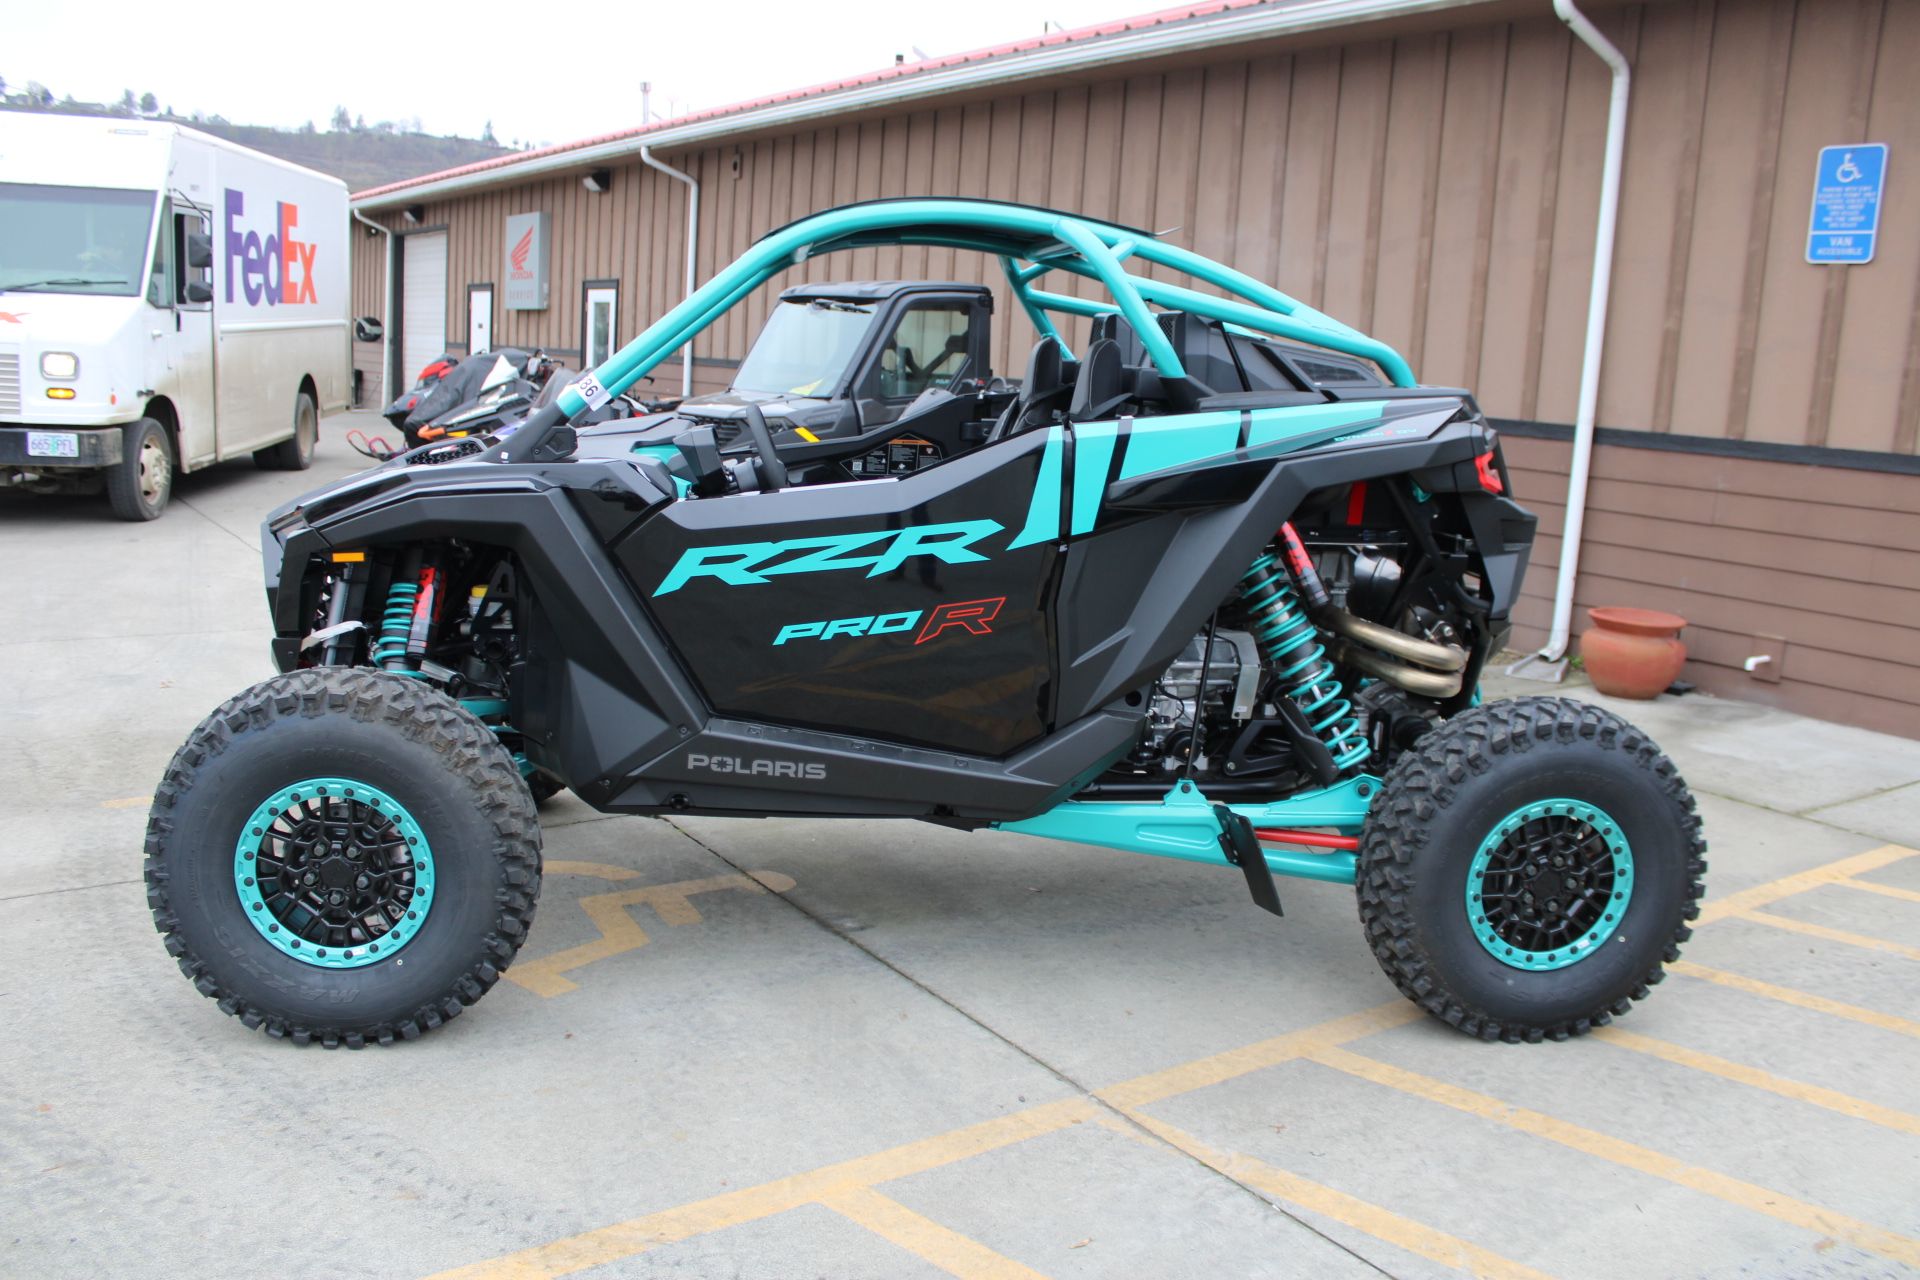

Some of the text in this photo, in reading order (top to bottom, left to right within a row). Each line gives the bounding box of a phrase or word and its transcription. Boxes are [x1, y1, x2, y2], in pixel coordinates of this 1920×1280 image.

[224, 187, 318, 307] FedEx
[1829, 236, 1853, 247] VAN
[510, 271, 534, 281] HONDA
[652, 519, 1006, 598] RZR
[772, 597, 1006, 646] PRO R
[687, 753, 827, 780] POLARIS
